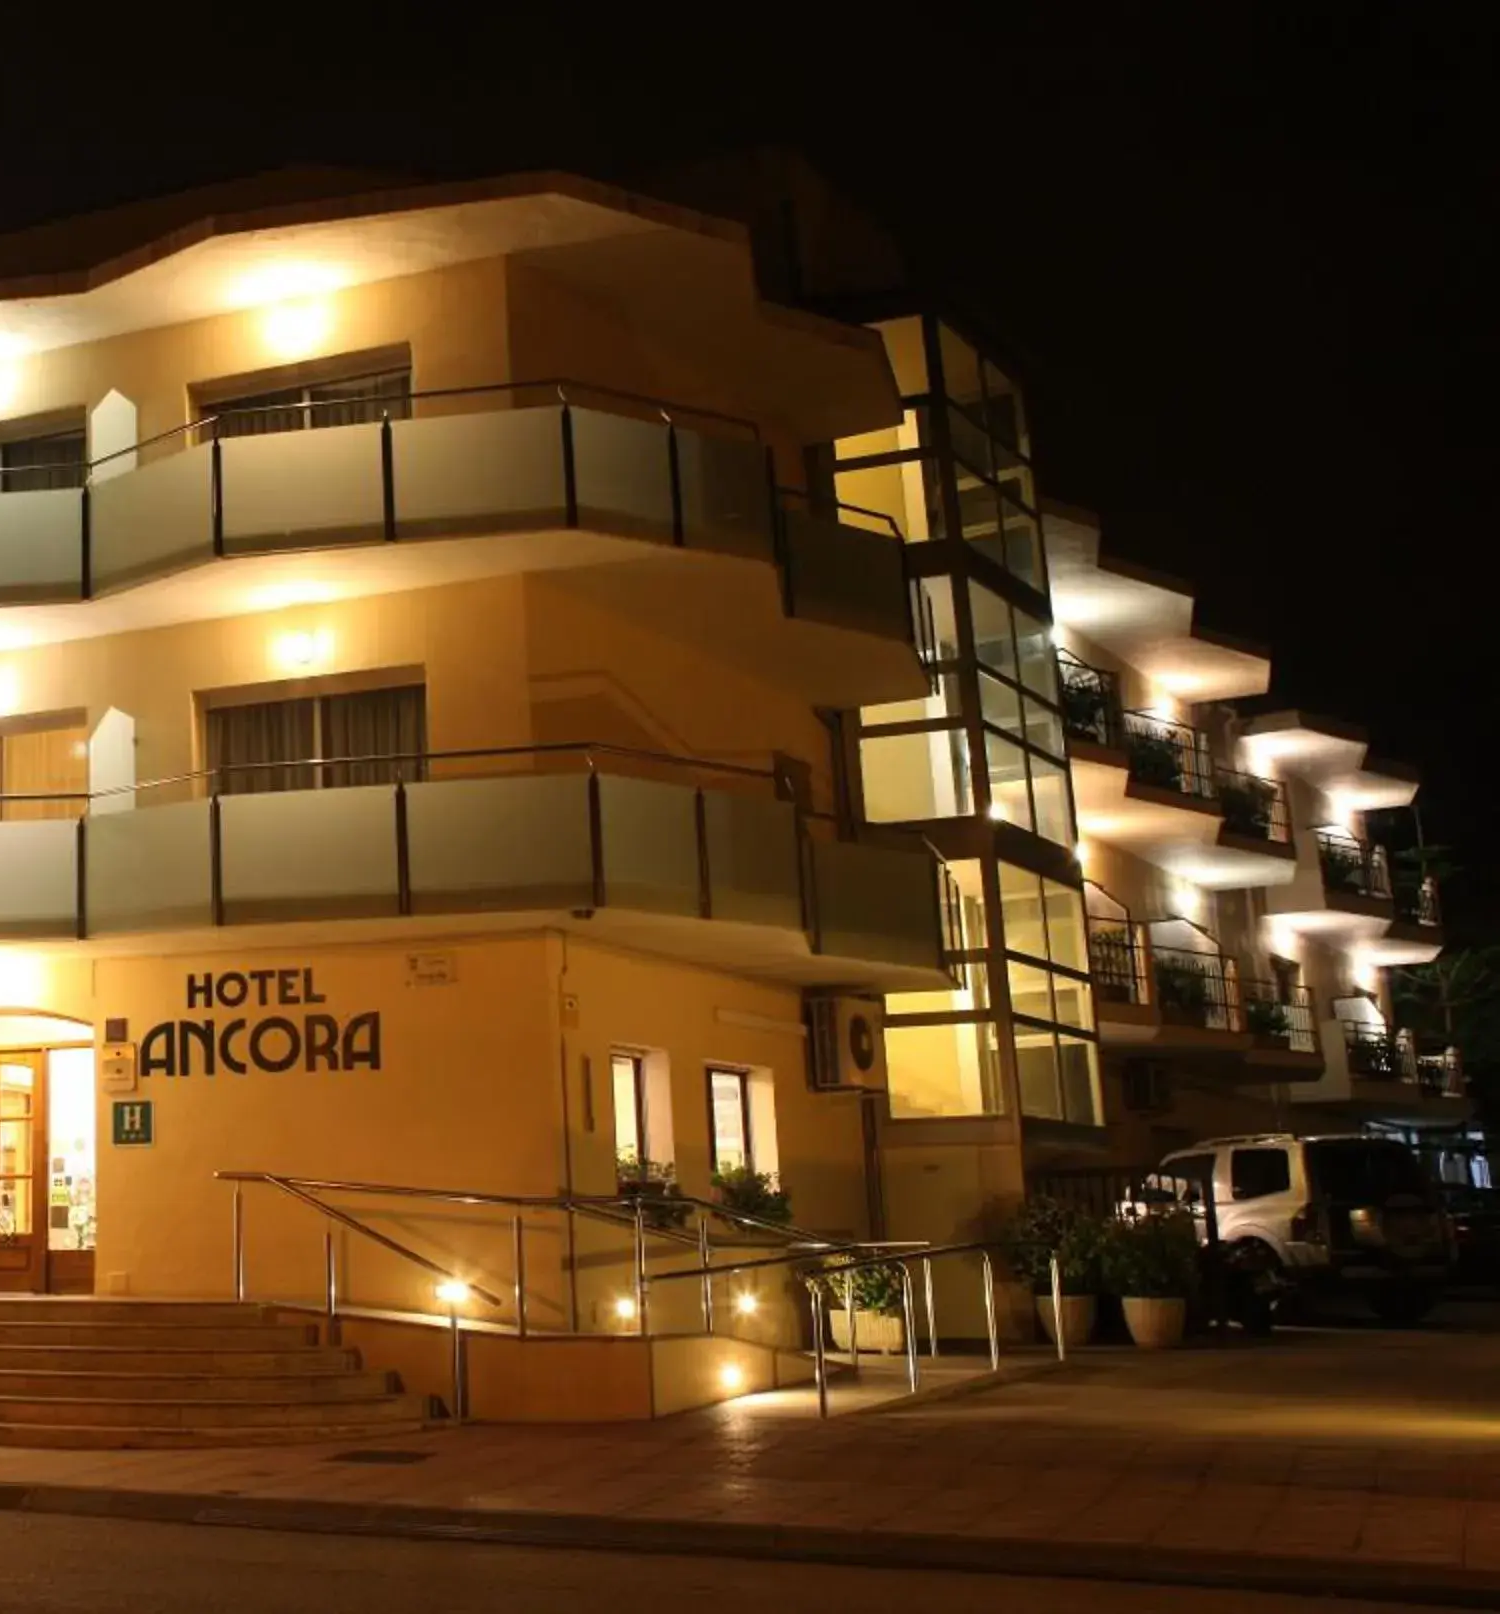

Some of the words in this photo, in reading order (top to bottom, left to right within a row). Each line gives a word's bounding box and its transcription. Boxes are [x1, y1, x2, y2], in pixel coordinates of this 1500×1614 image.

[186, 967, 327, 1009] HOTEL
[140, 1011, 382, 1077] ANCORA
[123, 1105, 142, 1131] H
